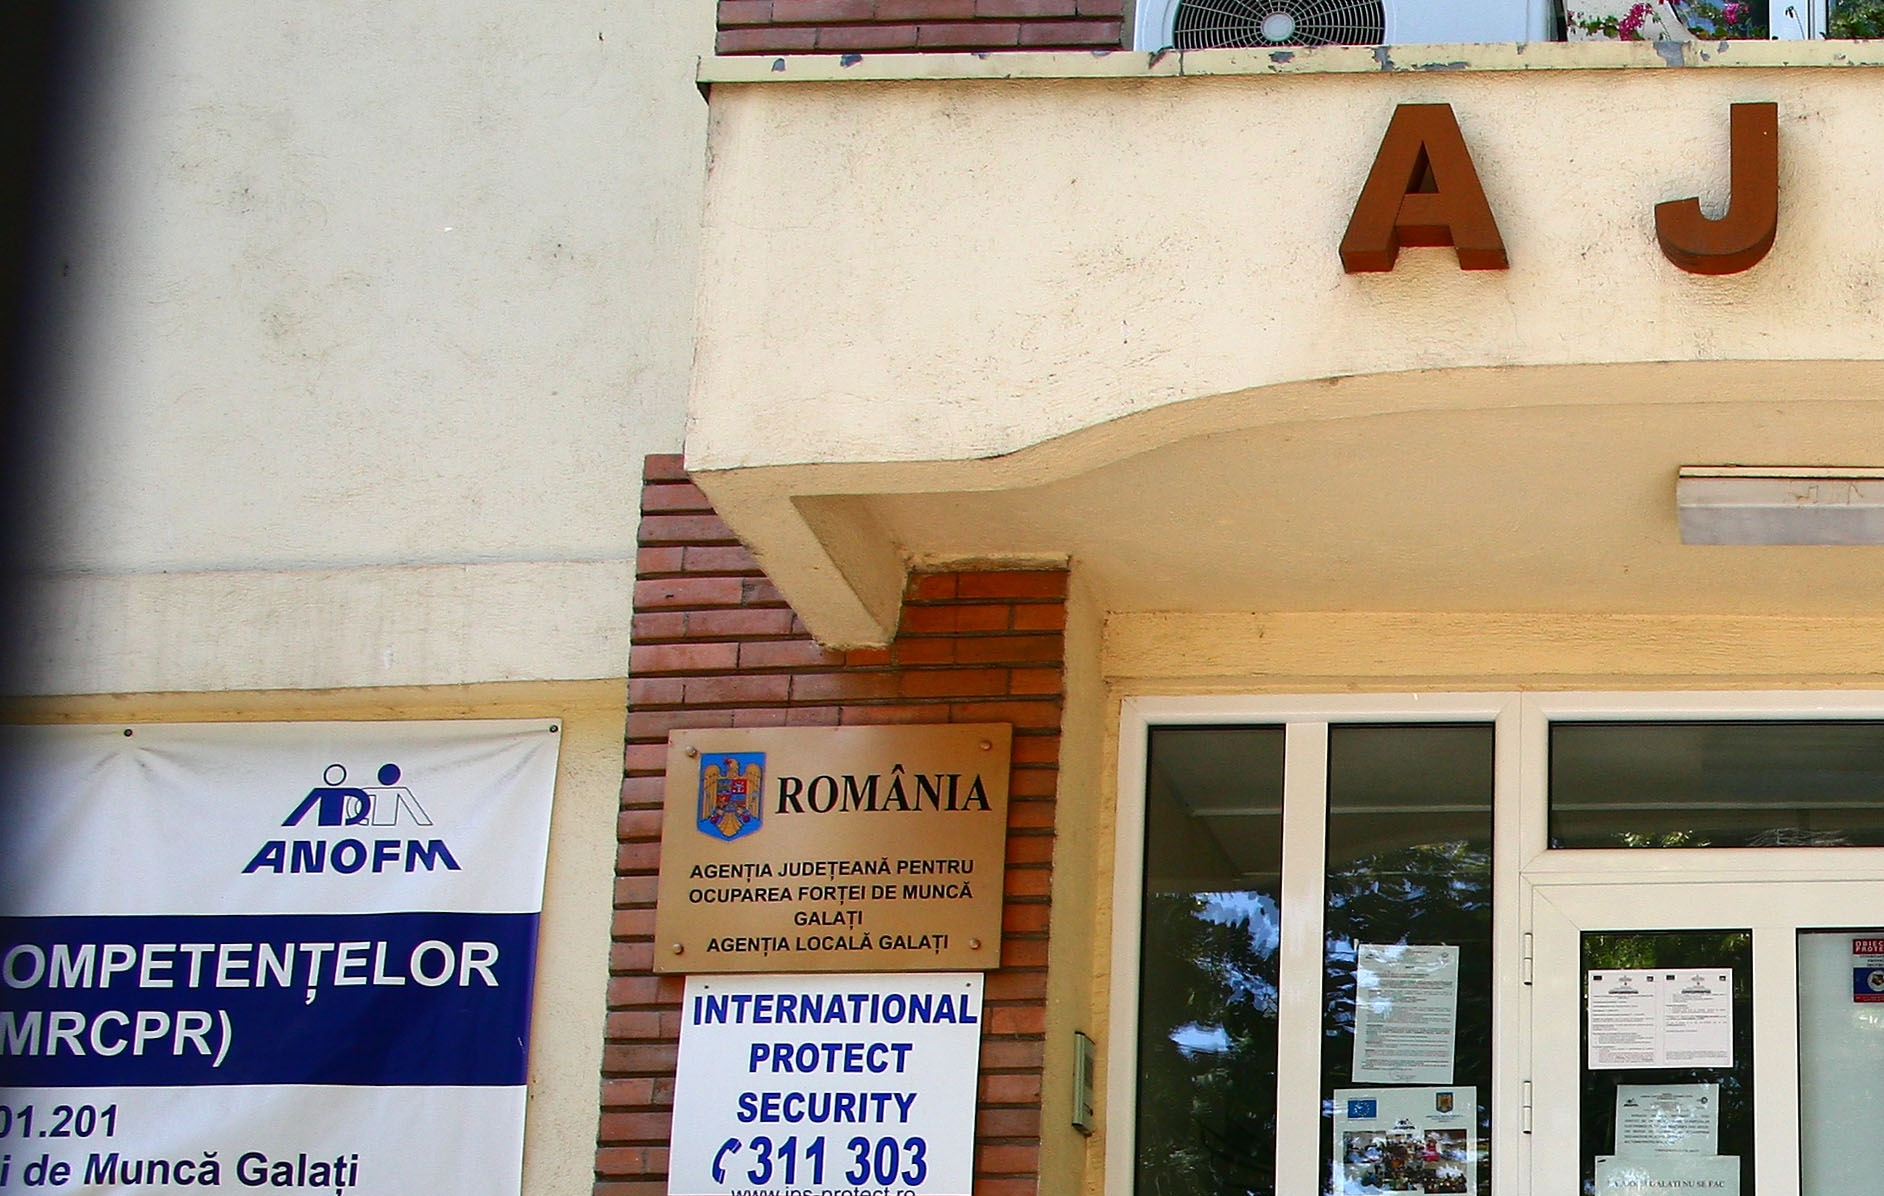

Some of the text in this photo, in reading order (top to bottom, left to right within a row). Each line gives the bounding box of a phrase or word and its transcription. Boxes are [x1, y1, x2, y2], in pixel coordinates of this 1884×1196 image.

[775, 764, 993, 814] ROMÂNIA
[241, 839, 462, 874] ANOFM
[690, 858, 973, 882] AGENȚIA JUDEȚEANĂ PENTRU
[689, 881, 972, 905] OCUPAREA FORȚEI DE MUNCĂ
[794, 910, 863, 930] GALAȚI
[707, 932, 948, 956] AGENȚIA LOCALĂ GALAȚI
[693, 993, 977, 1025] INTERNATIONAL
[749, 1042, 913, 1073] PROTECT
[736, 1091, 917, 1123] SECURITY
[23, 1154, 71, 1186] de
[84, 1151, 221, 1186] Muncă
[747, 1136, 928, 1186] 311 303
